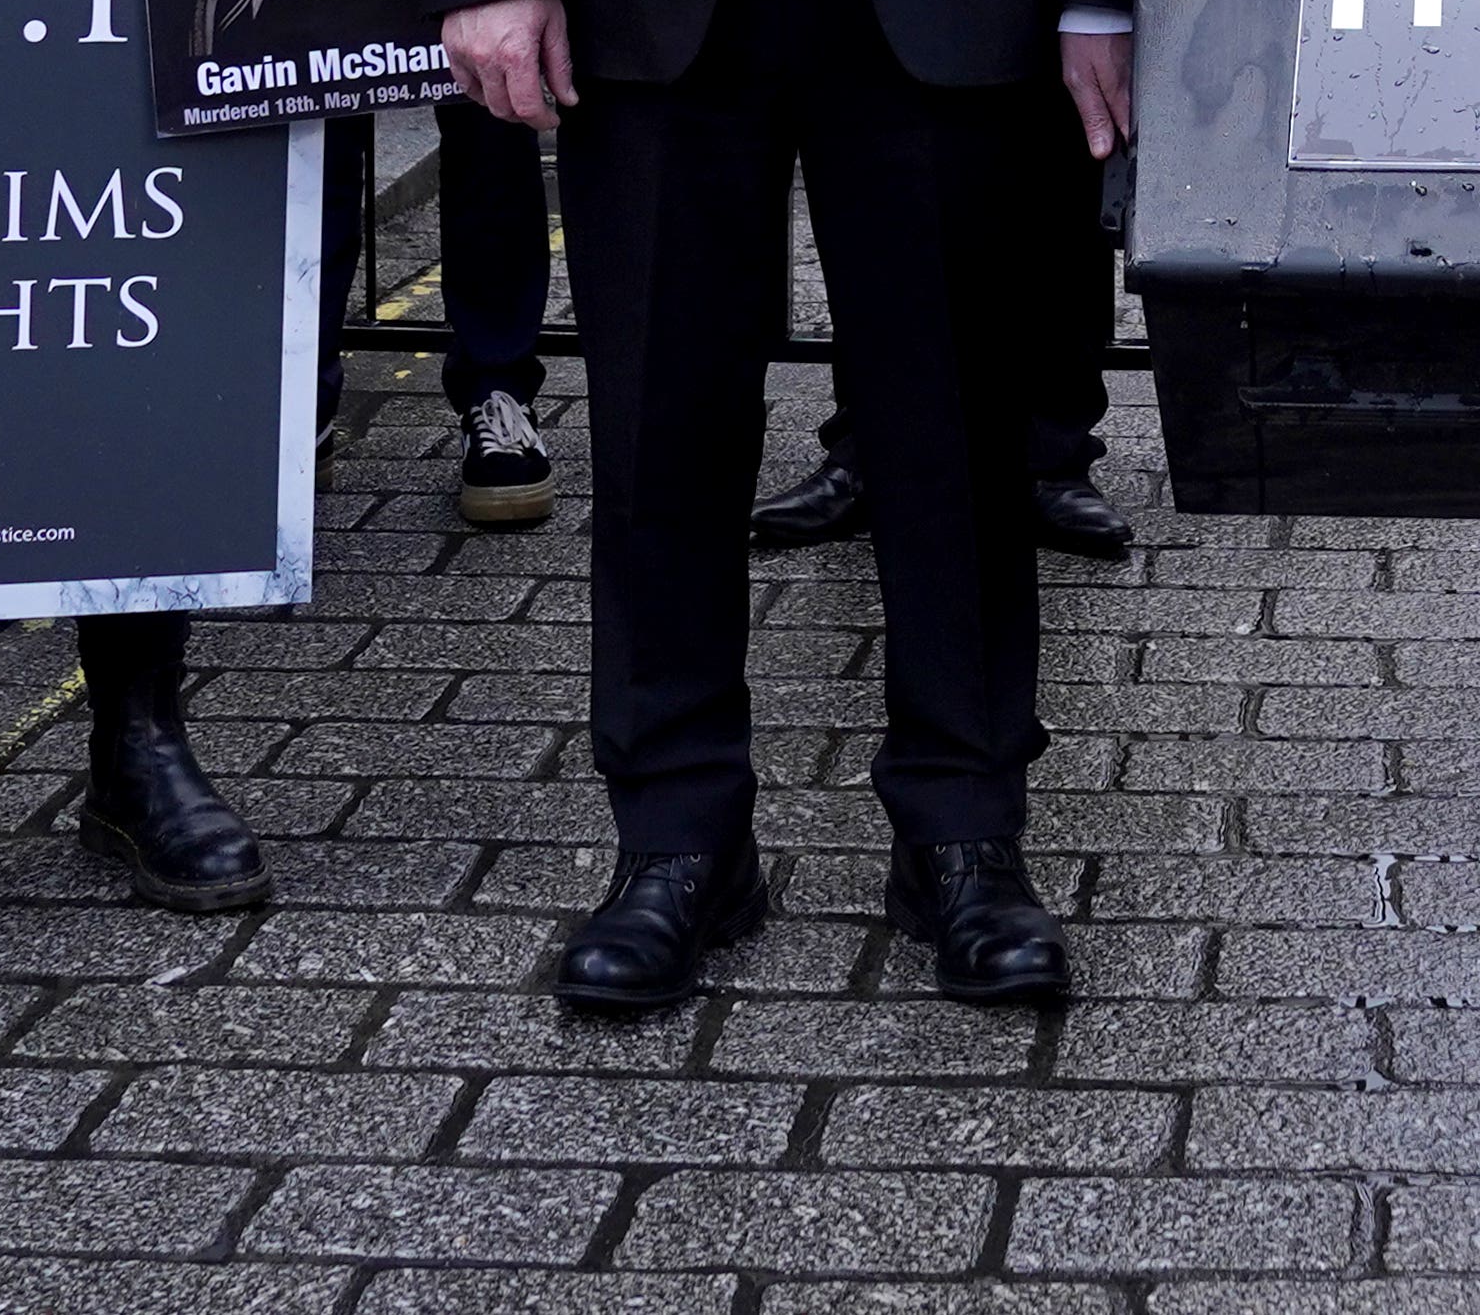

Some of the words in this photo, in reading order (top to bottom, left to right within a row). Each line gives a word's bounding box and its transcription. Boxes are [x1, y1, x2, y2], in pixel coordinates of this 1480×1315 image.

[196, 55, 298, 96] Gavin
[183, 100, 270, 126] Murdered
[274, 95, 320, 115] 18th.
[324, 91, 361, 109] May
[365, 84, 416, 105] 1994.
